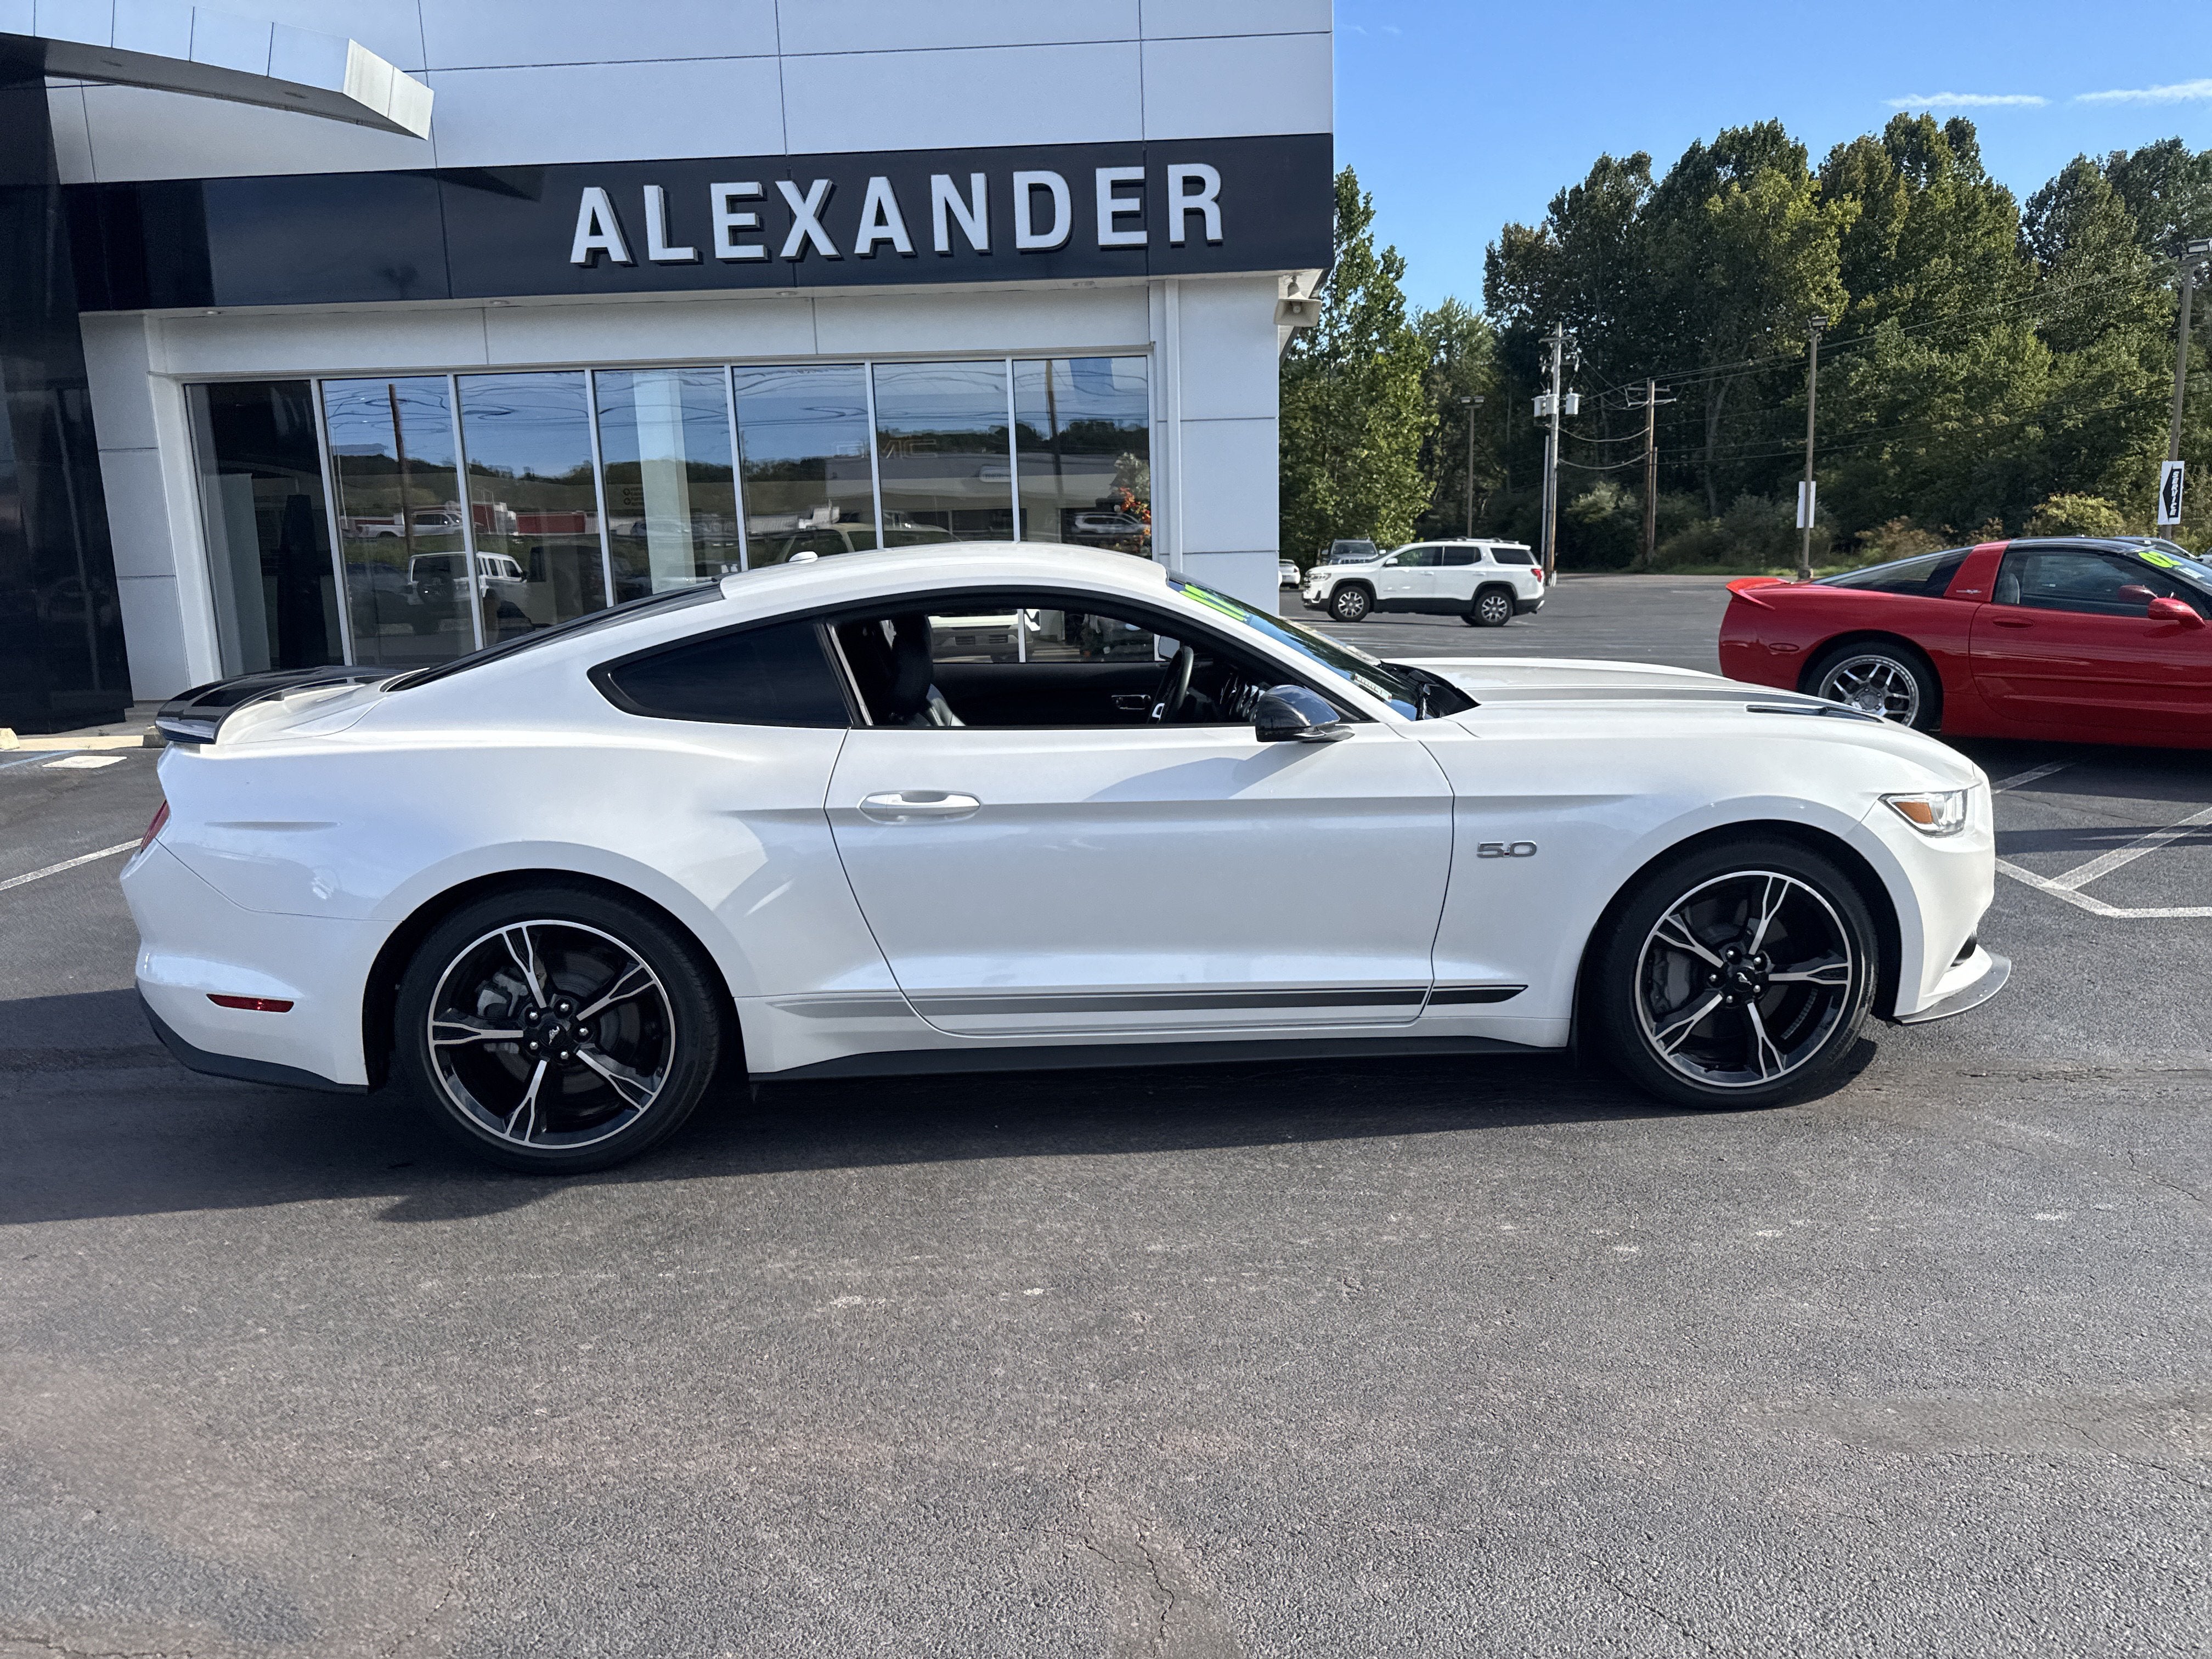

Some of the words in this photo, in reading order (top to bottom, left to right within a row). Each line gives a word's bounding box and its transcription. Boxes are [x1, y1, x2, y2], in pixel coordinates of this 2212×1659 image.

[569, 163, 1223, 266] ALEXANDER
[2169, 471, 2180, 516] SERVICE
[1476, 840, 1537, 858] 5.0
